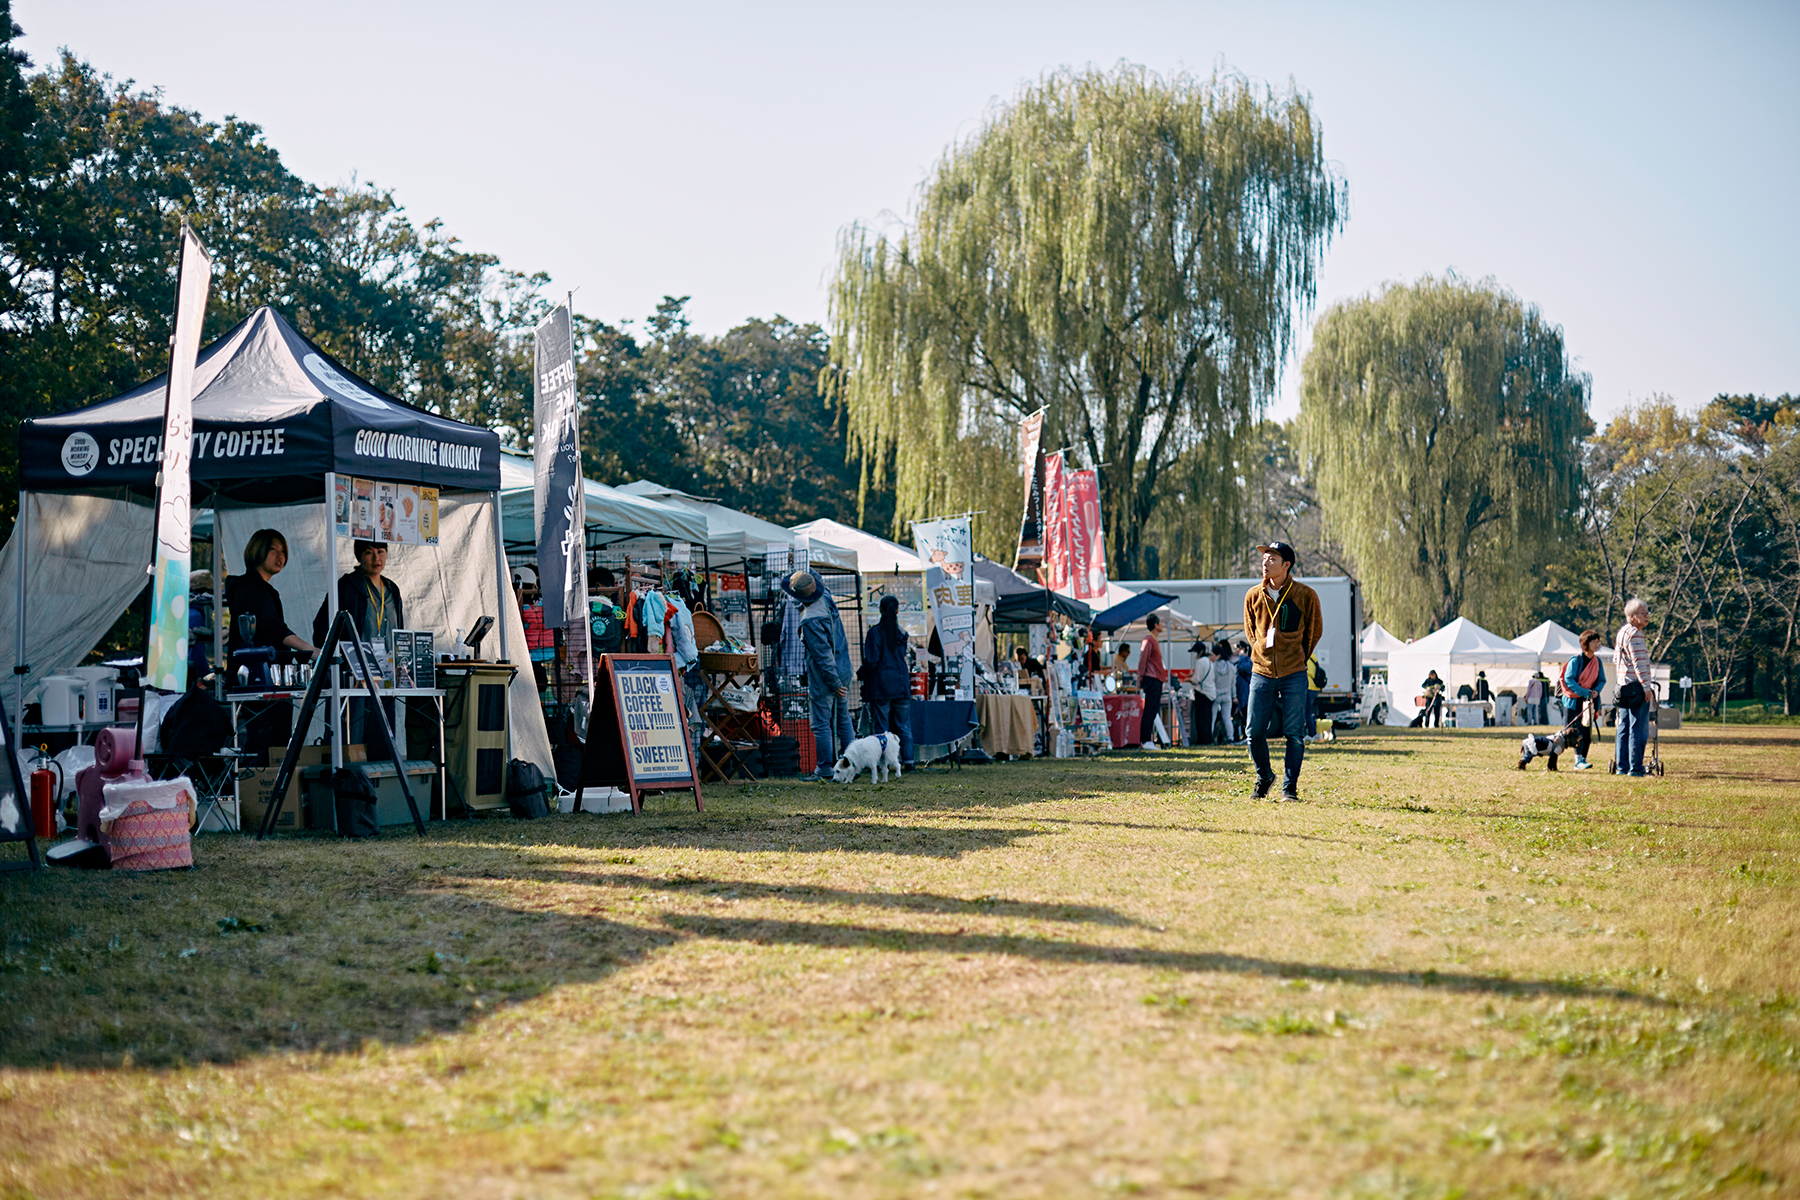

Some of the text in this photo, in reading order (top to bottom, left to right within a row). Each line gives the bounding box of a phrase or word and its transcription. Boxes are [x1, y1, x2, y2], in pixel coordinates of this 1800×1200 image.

[107, 427, 286, 466] SPECITY COFFEE
[354, 428, 482, 471] GOOD MORNING MONDAY
[621, 676, 659, 694] BLACK
[624, 695, 664, 713] COFFEE
[631, 731, 648, 746] BUT
[634, 745, 683, 764] SWEET!!!!
